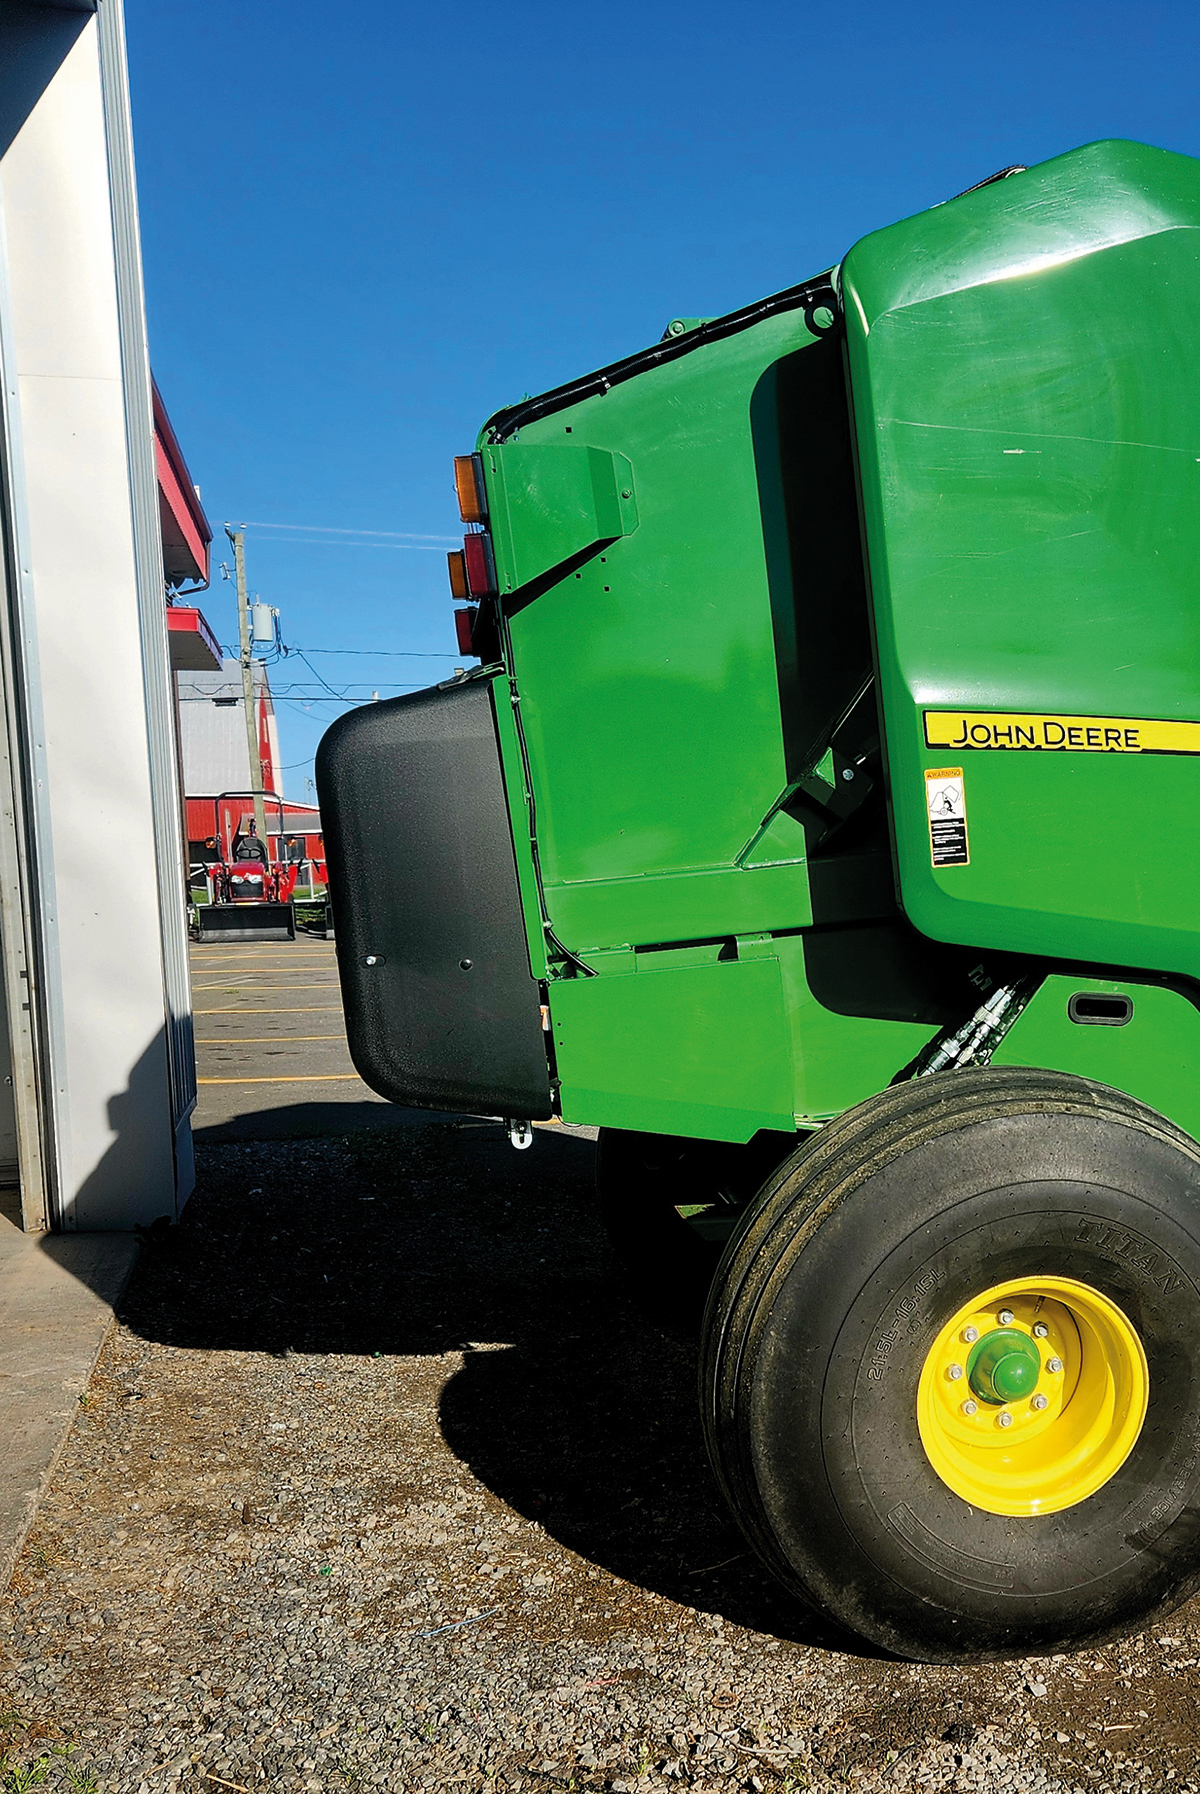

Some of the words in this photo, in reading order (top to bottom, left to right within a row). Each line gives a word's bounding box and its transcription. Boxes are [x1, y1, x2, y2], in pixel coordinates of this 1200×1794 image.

[953, 720, 1035, 744] JOHN
[1043, 722, 1141, 748] DEERE
[1074, 1218, 1188, 1294] TITAN
[867, 1268, 946, 1381] 21.5L-16.1SL
[1151, 1458, 1196, 1522] SERVICE
